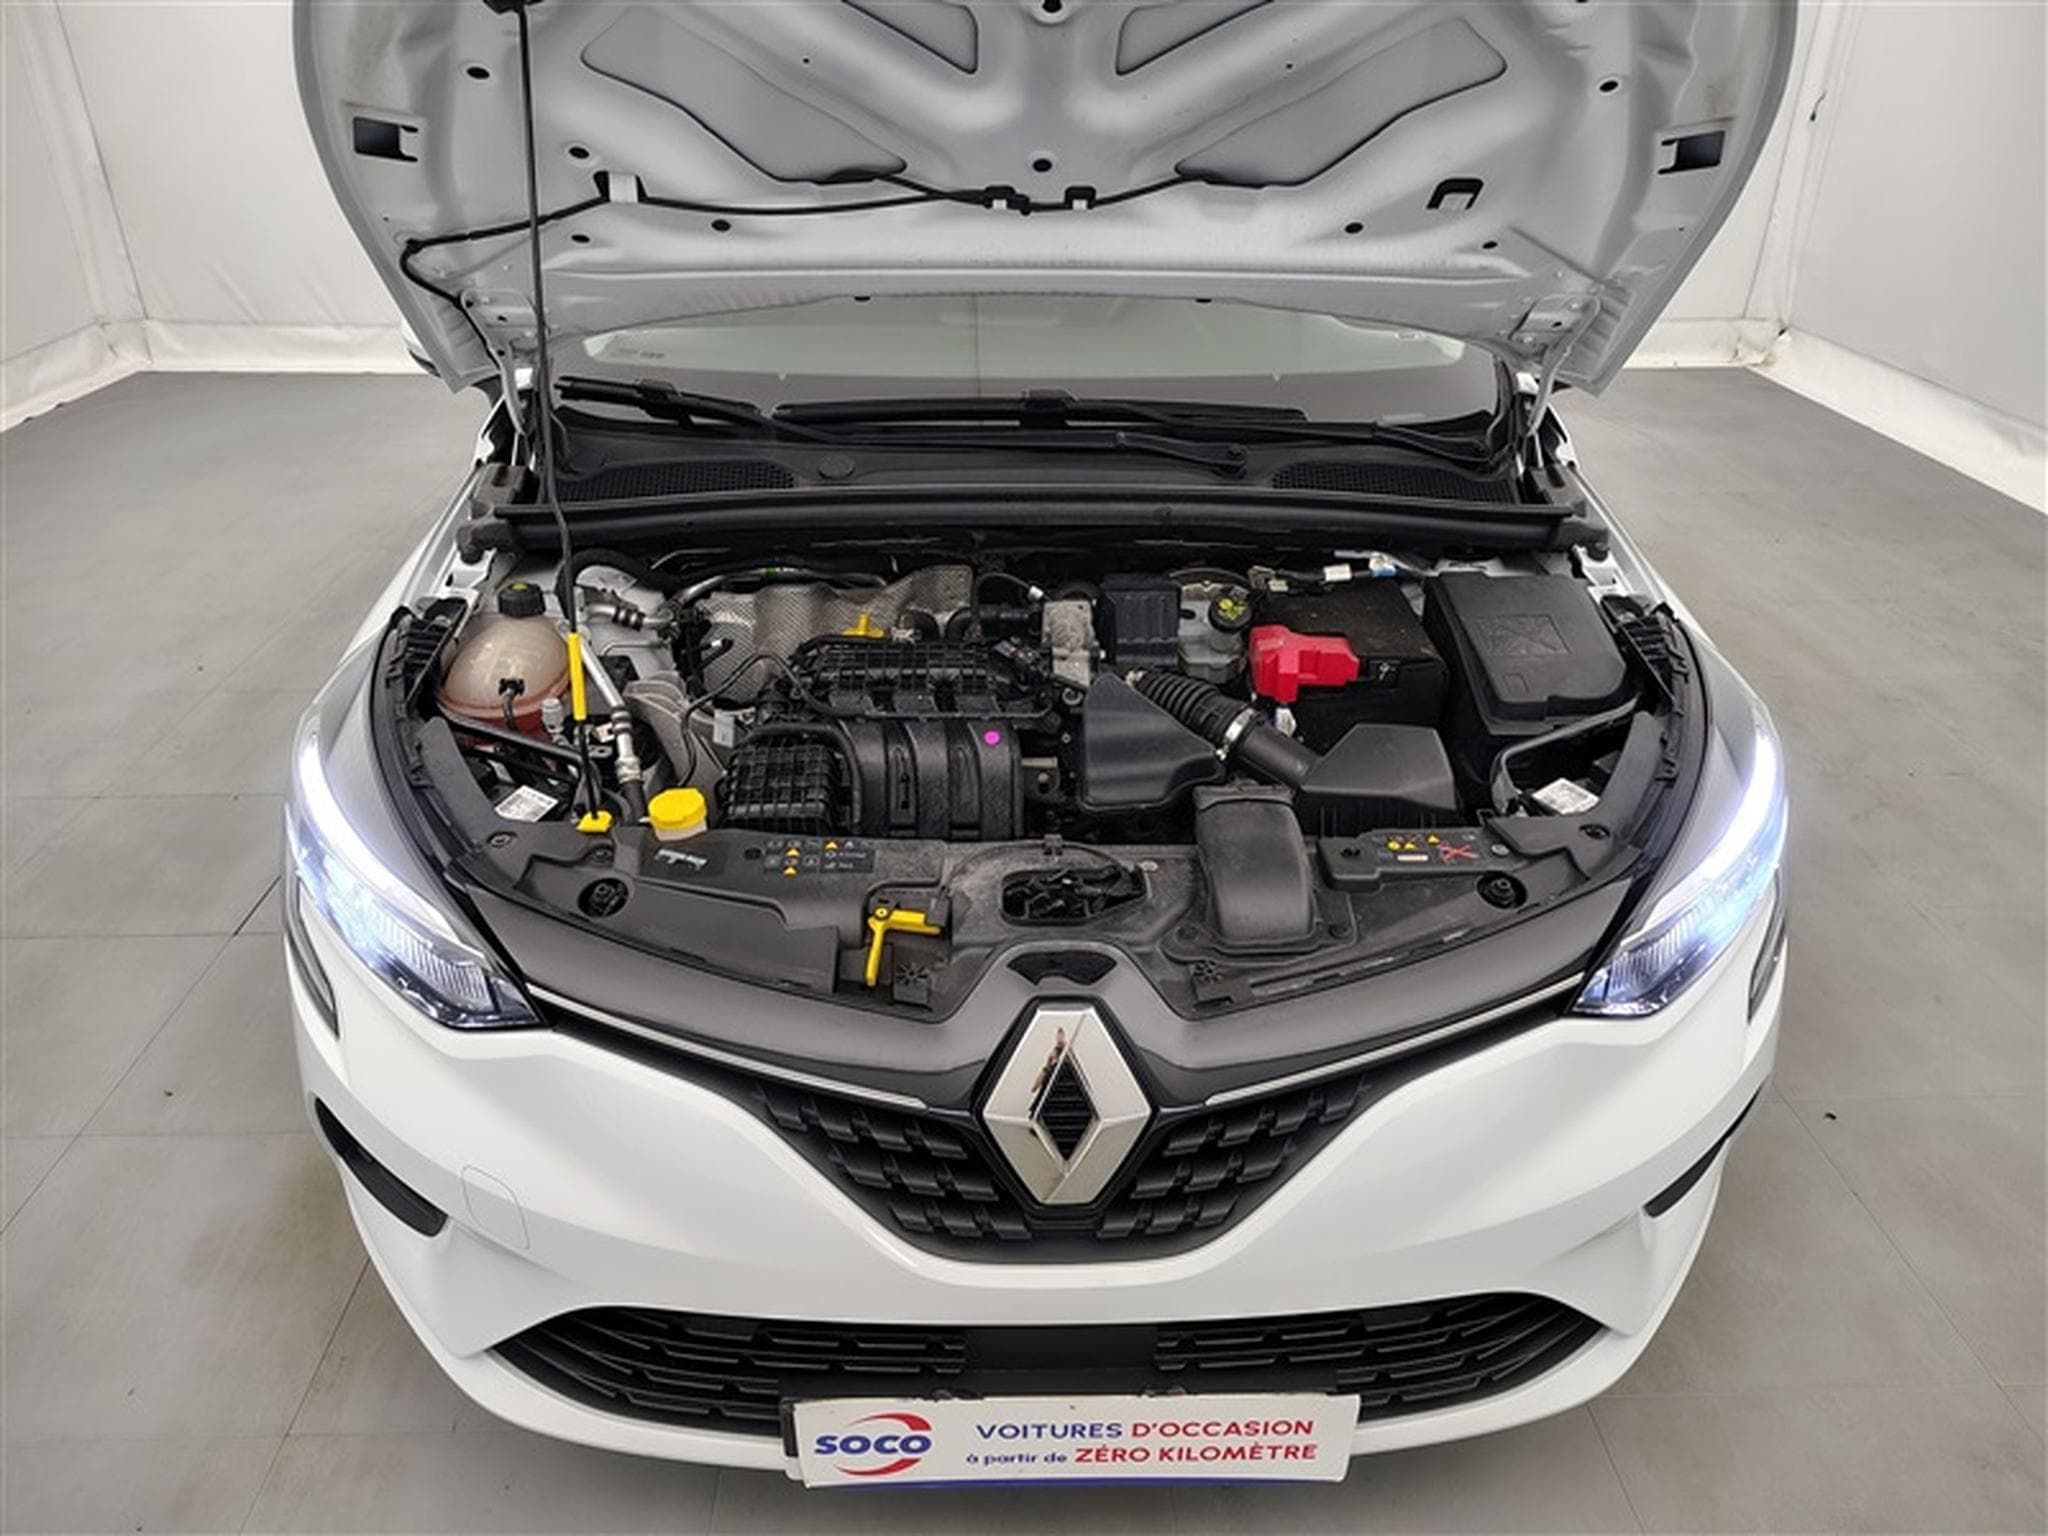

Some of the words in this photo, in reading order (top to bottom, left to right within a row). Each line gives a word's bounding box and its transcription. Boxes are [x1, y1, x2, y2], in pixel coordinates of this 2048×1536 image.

[976, 1422, 1122, 1440] VOITURES
[1131, 1420, 1314, 1438] D'OCCASION
[813, 1434, 932, 1455] SOCO
[966, 1452, 978, 1464] à
[983, 1452, 1037, 1466] partir
[1043, 1452, 1068, 1463] de
[1075, 1444, 1151, 1463] ZÉRO
[1158, 1442, 1318, 1461] KILOMÈTRE
